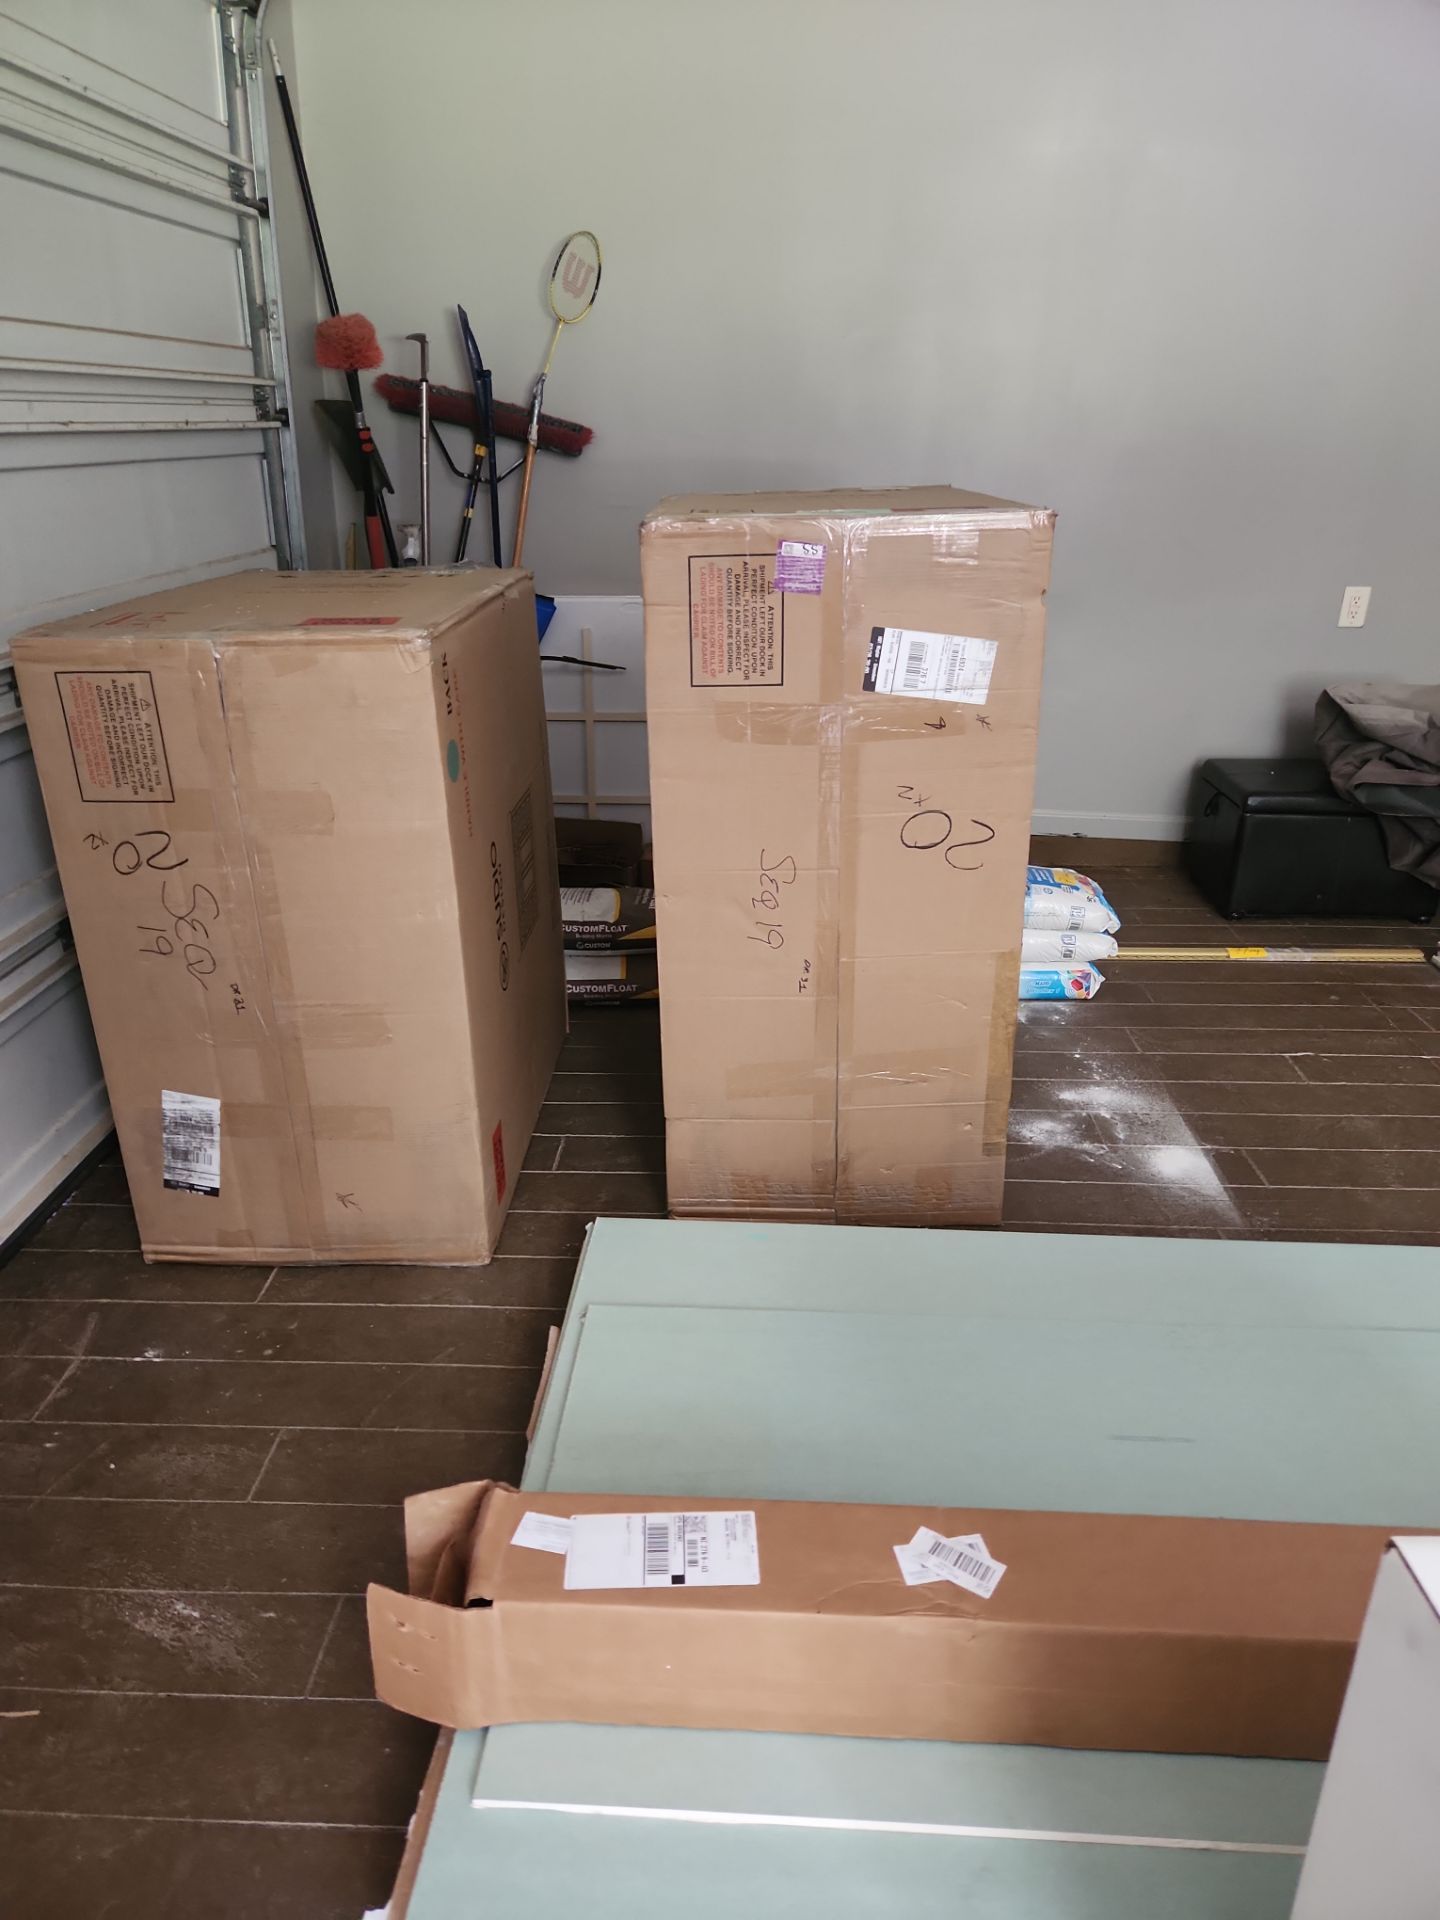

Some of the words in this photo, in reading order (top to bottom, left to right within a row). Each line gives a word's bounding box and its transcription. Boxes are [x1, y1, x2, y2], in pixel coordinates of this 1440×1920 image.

[709, 597, 715, 607] BE
[718, 622, 724, 631] TO
[710, 637, 715, 648] ON
[710, 669, 716, 678] OF
[441, 651, 453, 716] BACK
[104, 689, 117, 722] DAMAGE
[128, 683, 140, 721] SHIPMENT
[95, 685, 108, 723] QUANTITY
[103, 726, 114, 755] BEFORE
[111, 725, 120, 740] AND
[118, 716, 129, 745] PLEASE
[121, 687, 133, 721] PERFECT
[136, 769, 145, 789] UPON
[136, 724, 144, 741] LEFT
[139, 745, 147, 760] OUR
[115, 743, 128, 785] INCORRECT
[123, 748, 134, 778] INSPECT
[143, 762, 152, 782] DOCK
[131, 782, 139, 795] FOR
[566, 983, 639, 993] CUSTOMFLOAT
